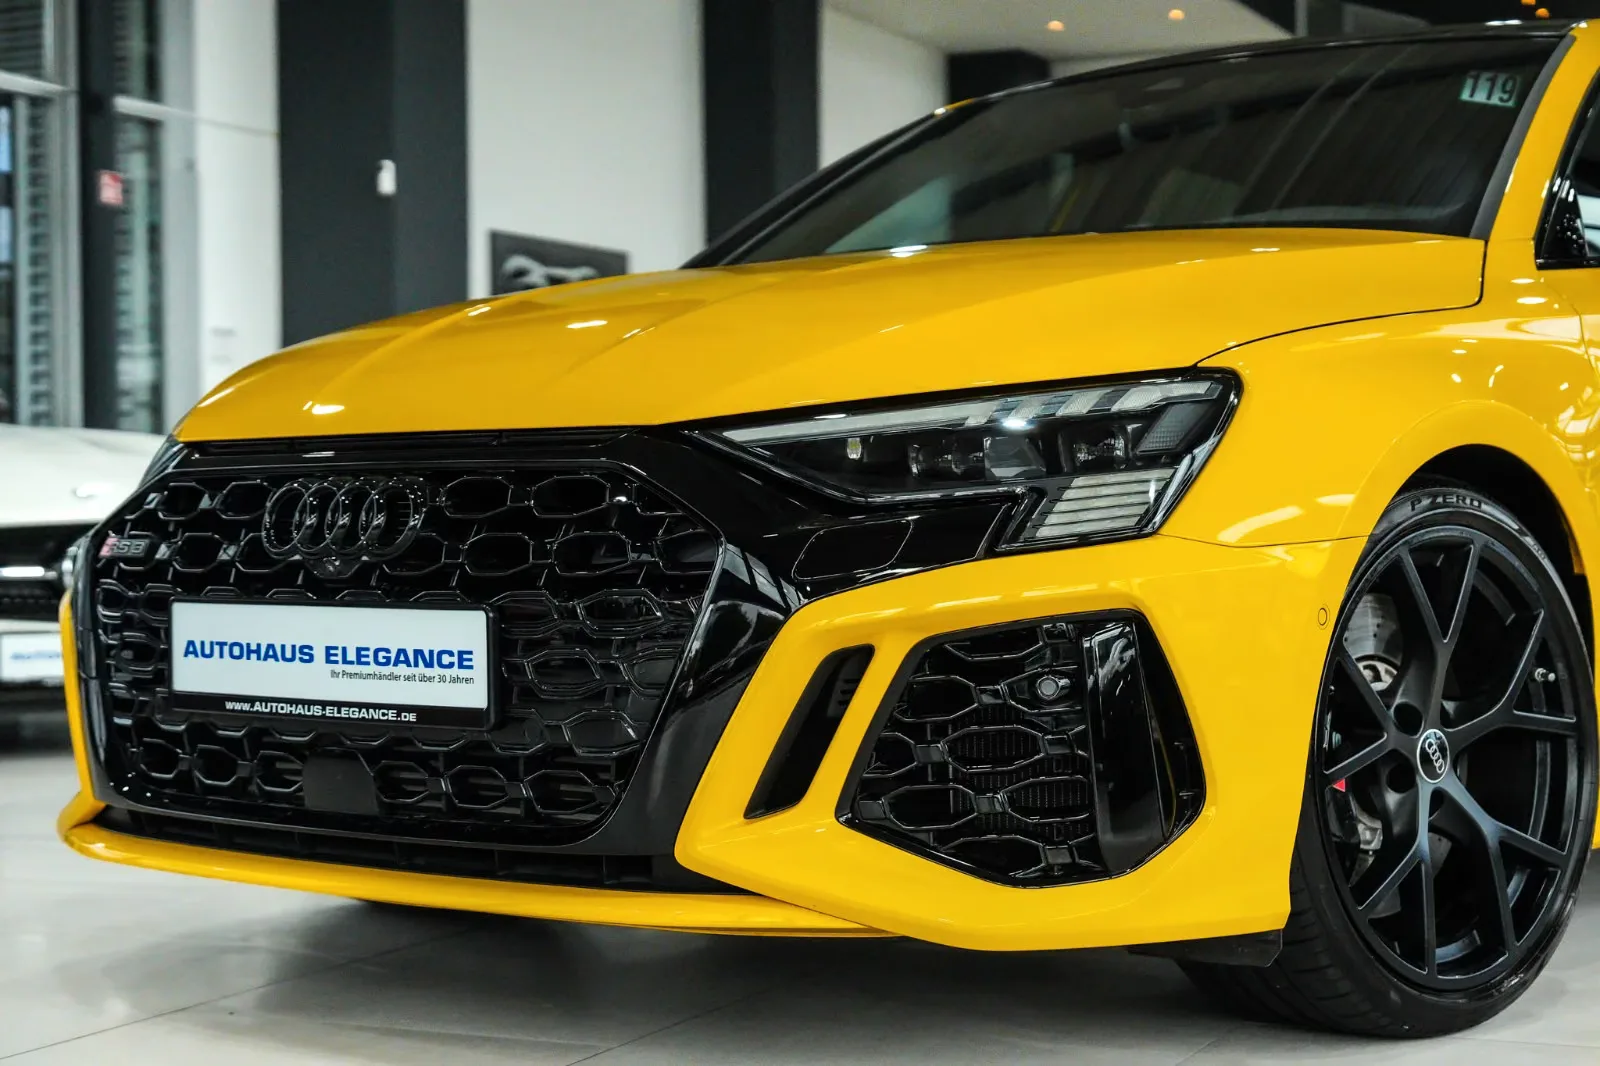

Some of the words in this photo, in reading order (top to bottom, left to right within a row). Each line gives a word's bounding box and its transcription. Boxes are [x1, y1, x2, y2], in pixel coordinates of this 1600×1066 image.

[1466, 71, 1517, 104] 119
[1410, 499, 1422, 512] P
[1428, 494, 1482, 509] ZERO
[183, 639, 315, 664] AUTOHAUS
[324, 645, 474, 670] ELEGANCE
[330, 669, 341, 679] Ihr
[341, 670, 402, 682] Premiumhändler
[403, 672, 417, 682] seit
[418, 673, 436, 683] über
[437, 674, 447, 684] 30
[448, 674, 475, 685] Jahren
[225, 700, 417, 722] www.AUTOHAUS-ELEGANCE.DE
